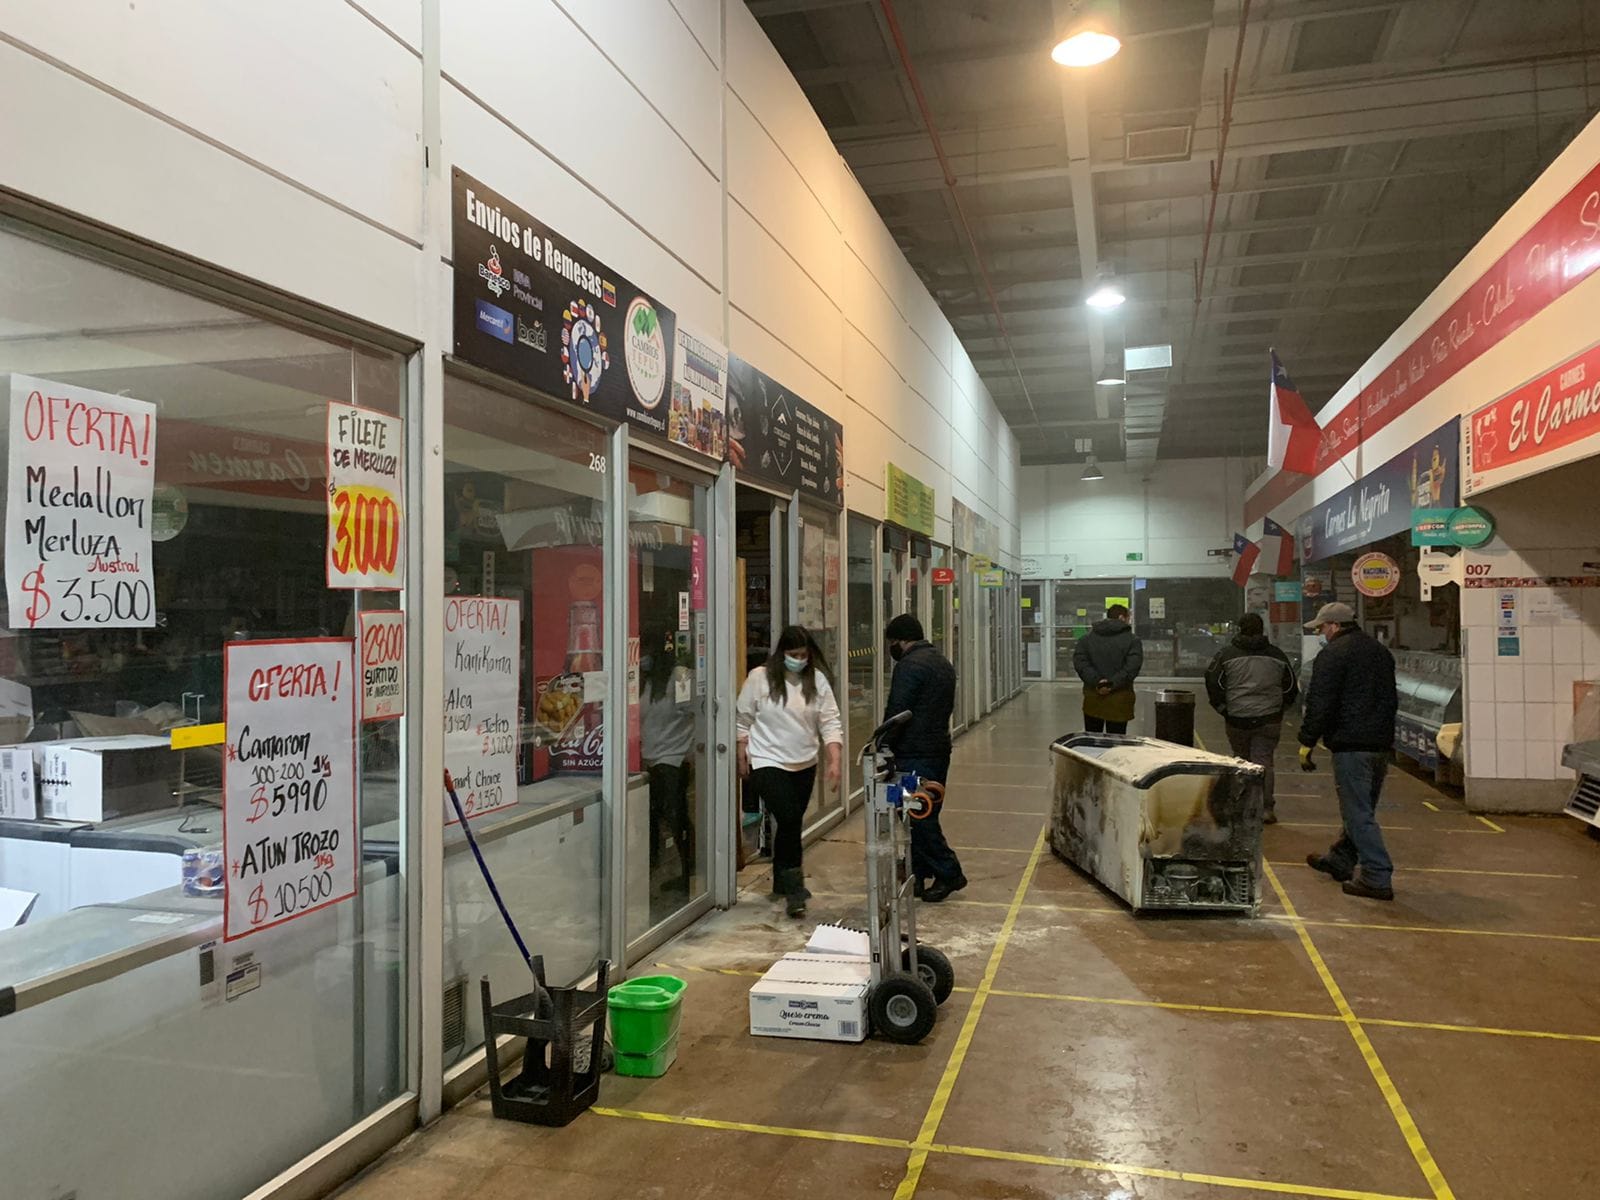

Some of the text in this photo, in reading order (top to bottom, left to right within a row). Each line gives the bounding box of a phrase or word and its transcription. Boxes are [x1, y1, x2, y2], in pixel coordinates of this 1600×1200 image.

[466, 188, 602, 299] Envios de Remesas
[479, 263, 511, 291] Banesco
[24, 390, 150, 466] OFERTA!
[1508, 400, 1530, 452] El
[333, 449, 350, 468] DE
[589, 452, 606, 474] 268
[26, 465, 145, 529] Medallon
[1360, 482, 1390, 532] Negrita
[88, 552, 140, 573] Austral
[1466, 565, 1492, 576] 007
[21, 563, 150, 628] $ 3.500
[445, 600, 508, 636] OFERTA!
[249, 660, 342, 702] OFERTA!
[238, 725, 311, 762] Camaron
[562, 759, 575, 767] SIN
[240, 829, 339, 880] ATUN TROZO
[779, 1010, 830, 1020] Queso crema
